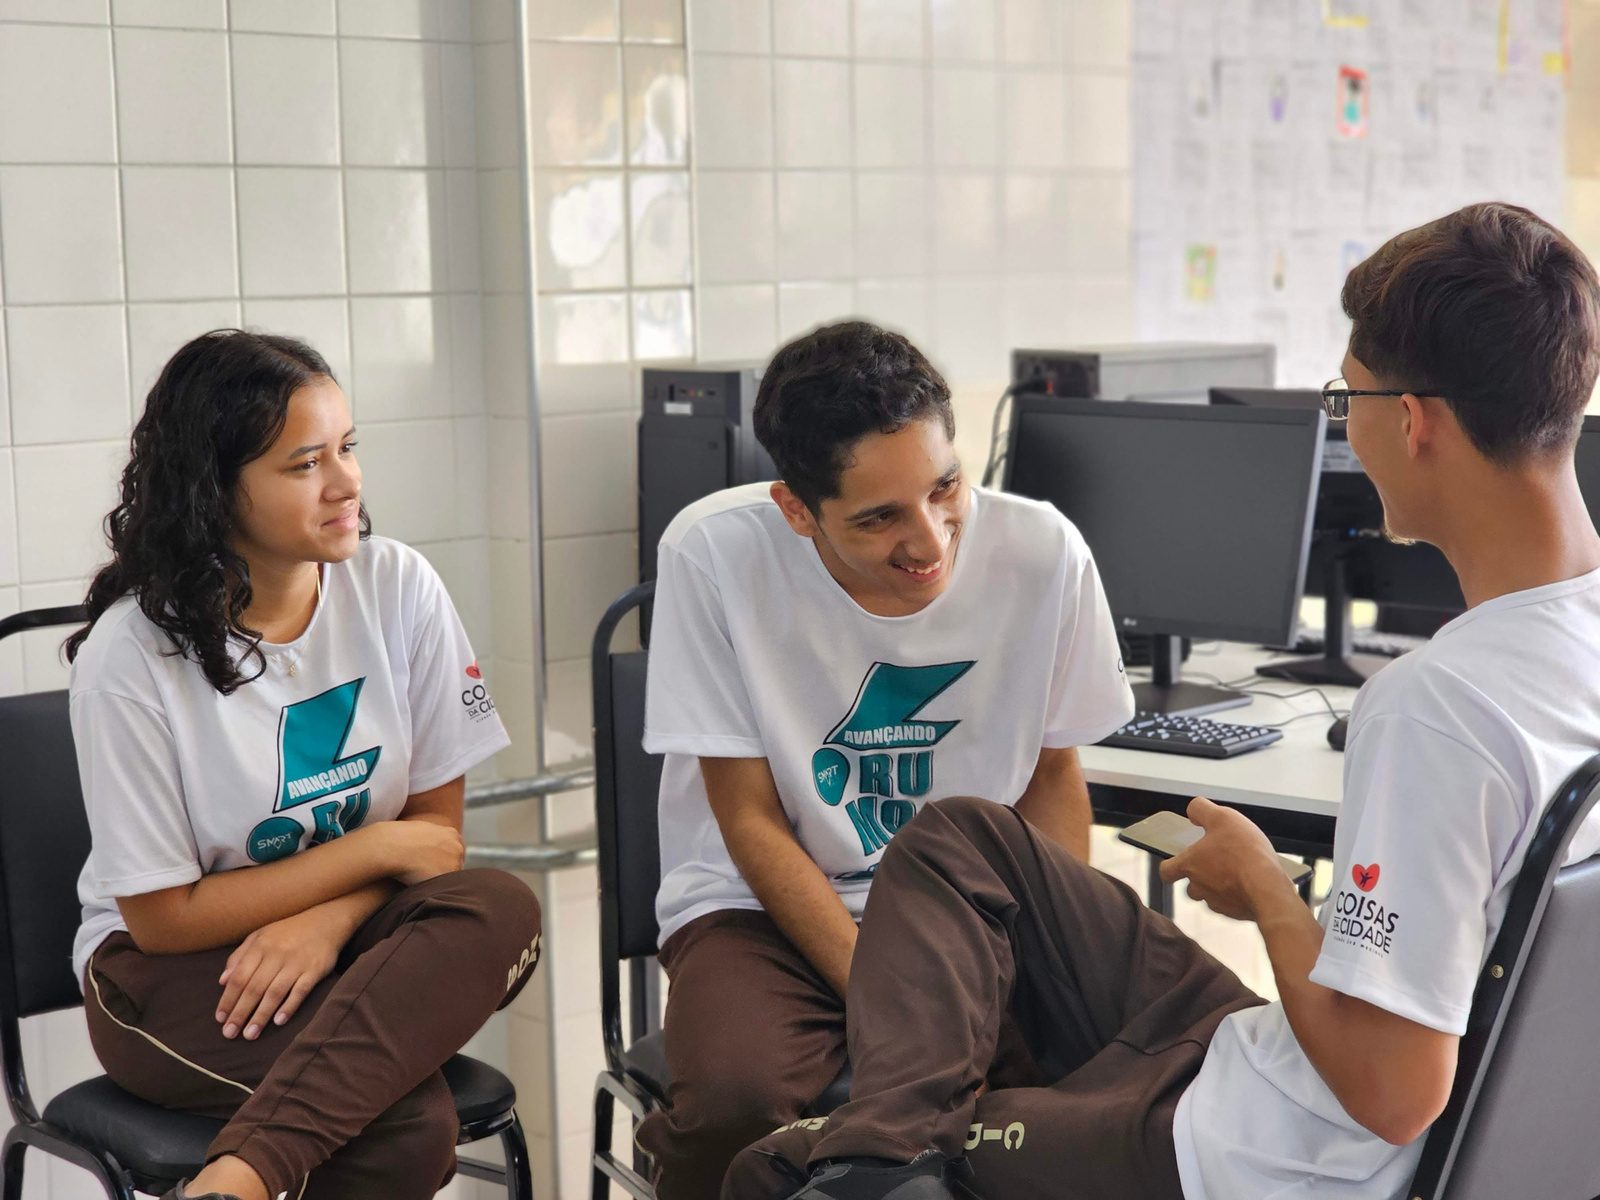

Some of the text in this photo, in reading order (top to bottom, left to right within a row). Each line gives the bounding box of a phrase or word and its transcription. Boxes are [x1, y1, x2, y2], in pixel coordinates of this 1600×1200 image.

[844, 725, 936, 746] AVANÇANDO
[287, 758, 368, 799] AVANÇANDO
[858, 750, 934, 798] RU
[1336, 891, 1399, 934] COISAS
[1340, 918, 1392, 954] CIDADE
